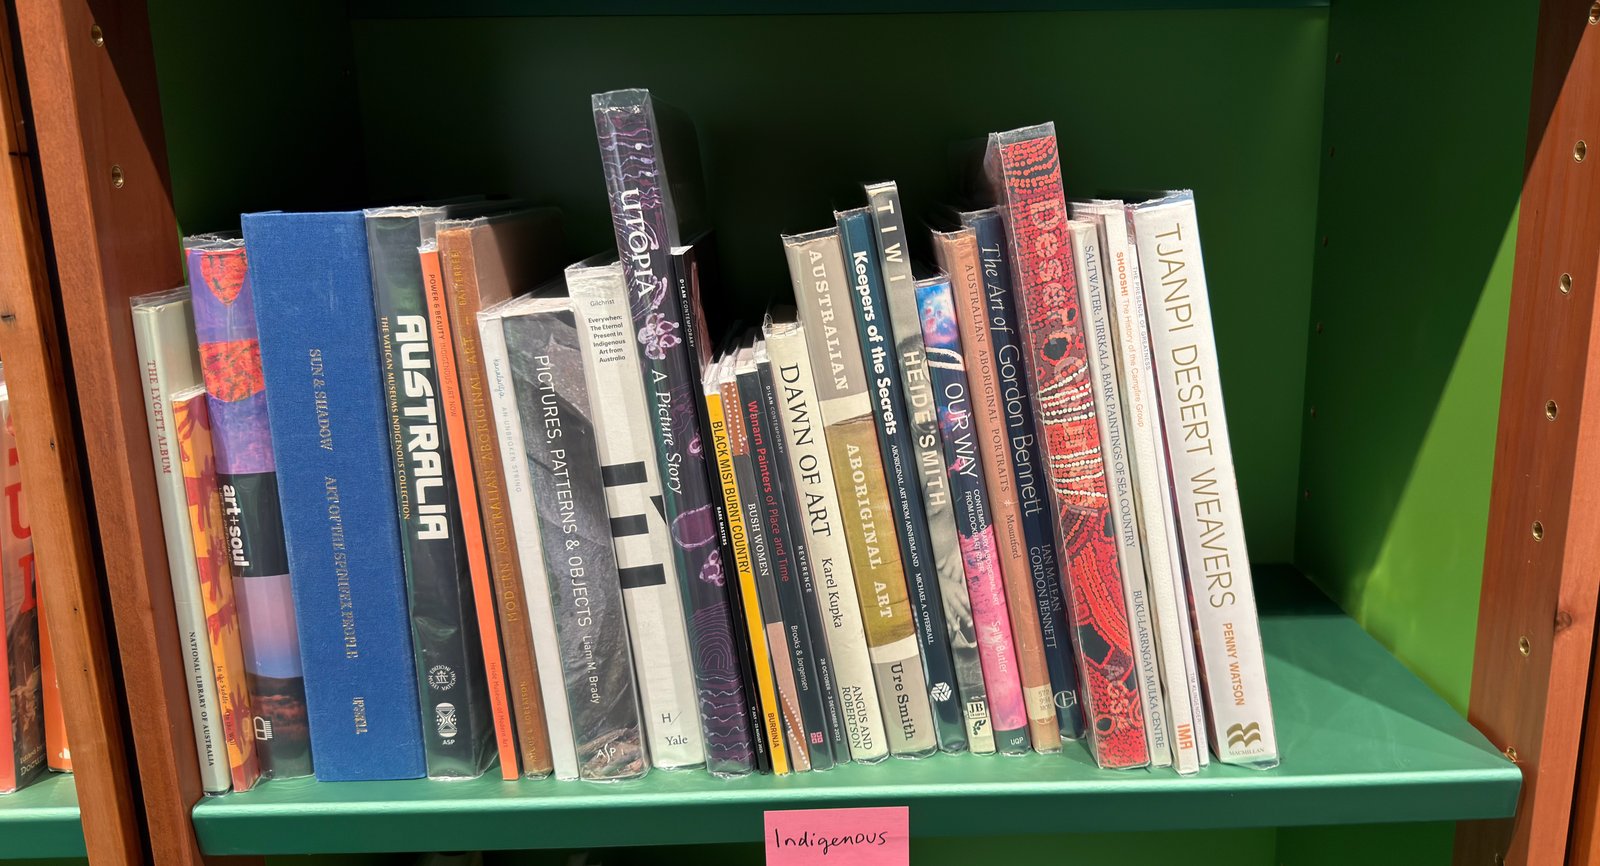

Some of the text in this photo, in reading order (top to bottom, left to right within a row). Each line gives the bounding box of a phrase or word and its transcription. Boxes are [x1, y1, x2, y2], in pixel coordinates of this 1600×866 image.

[621, 187, 656, 300] UTOPIA
[1116, 251, 1128, 297] SHOOSH!
[428, 274, 440, 300] POWER
[434, 310, 446, 340] BEAUTY
[588, 315, 622, 324] Everywhen:
[593, 332, 616, 340] Present
[602, 322, 624, 330] Eternal
[682, 299, 694, 348] CONTEMPORARY
[593, 339, 626, 348] Indigenous
[599, 355, 626, 364] Australia
[853, 250, 897, 436] Keepers of the Secrets
[1094, 317, 1109, 371] YIRRKALA
[309, 348, 334, 451] SUN & SHADOW
[964, 263, 1010, 493] AUSTRALIAN ABORIGINAL PORTRAITS
[981, 243, 1042, 517] The Art of Gordon Bennett
[1102, 372, 1114, 402] BARK
[147, 360, 172, 475] THE LYCETT ALBUM
[380, 316, 411, 520] THE VATICAN MUSEUMS INDIGENOUS COLLECTION
[395, 315, 450, 541] AUSTRALIA
[651, 369, 682, 495] A Picture Story
[808, 249, 894, 619] AUSTRALIAN ABORIGINAL ART
[903, 350, 946, 507] HEIDE SMITH
[944, 382, 978, 478] OUR WAY
[1106, 403, 1123, 461] PAINTINGS
[747, 400, 790, 583] Wanarn Painters of Place and Time
[780, 362, 843, 629] DAWN OF ART Karel Kupka
[892, 444, 903, 486] ABORIGINAL
[902, 500, 910, 518] FROM
[1114, 461, 1125, 476] OF
[1117, 477, 1127, 497] SEA
[1155, 222, 1245, 707] TJANPI DESERT WEAVERS PENNY WATSON
[534, 355, 600, 705] PICTURES, PATTERNS & OBJECTS Liam M. Brady
[712, 420, 750, 575] BLACK MIST BURNT COUNTRY
[965, 490, 974, 512] FROM
[1120, 497, 1136, 548] COUNTRY
[747, 503, 770, 577] BUSH WOMEN
[797, 545, 812, 593] REVERENCE
[1006, 514, 1021, 560] Mountford
[1041, 543, 1053, 565] IAN
[501, 562, 519, 623] MODERN
[915, 573, 926, 602] MICHAEL
[1030, 546, 1058, 649] GORDON BENNETT
[790, 625, 809, 691] Brooks Jorgensen
[188, 631, 214, 767] NATIONAL LIBRARY OF AUSTRALIA
[767, 711, 780, 749] BURRINJA
[842, 686, 862, 750] ROBERTSON
[852, 685, 874, 751] ANGUS AND
[890, 661, 916, 741] Ure Smith
[970, 703, 983, 714] JB
[1145, 676, 1164, 749] MULKA CENTRE
[665, 735, 688, 746] Yale
[1010, 736, 1024, 746] UQP
[1177, 723, 1194, 750] IMA
[774, 828, 888, 856] Indigenous
